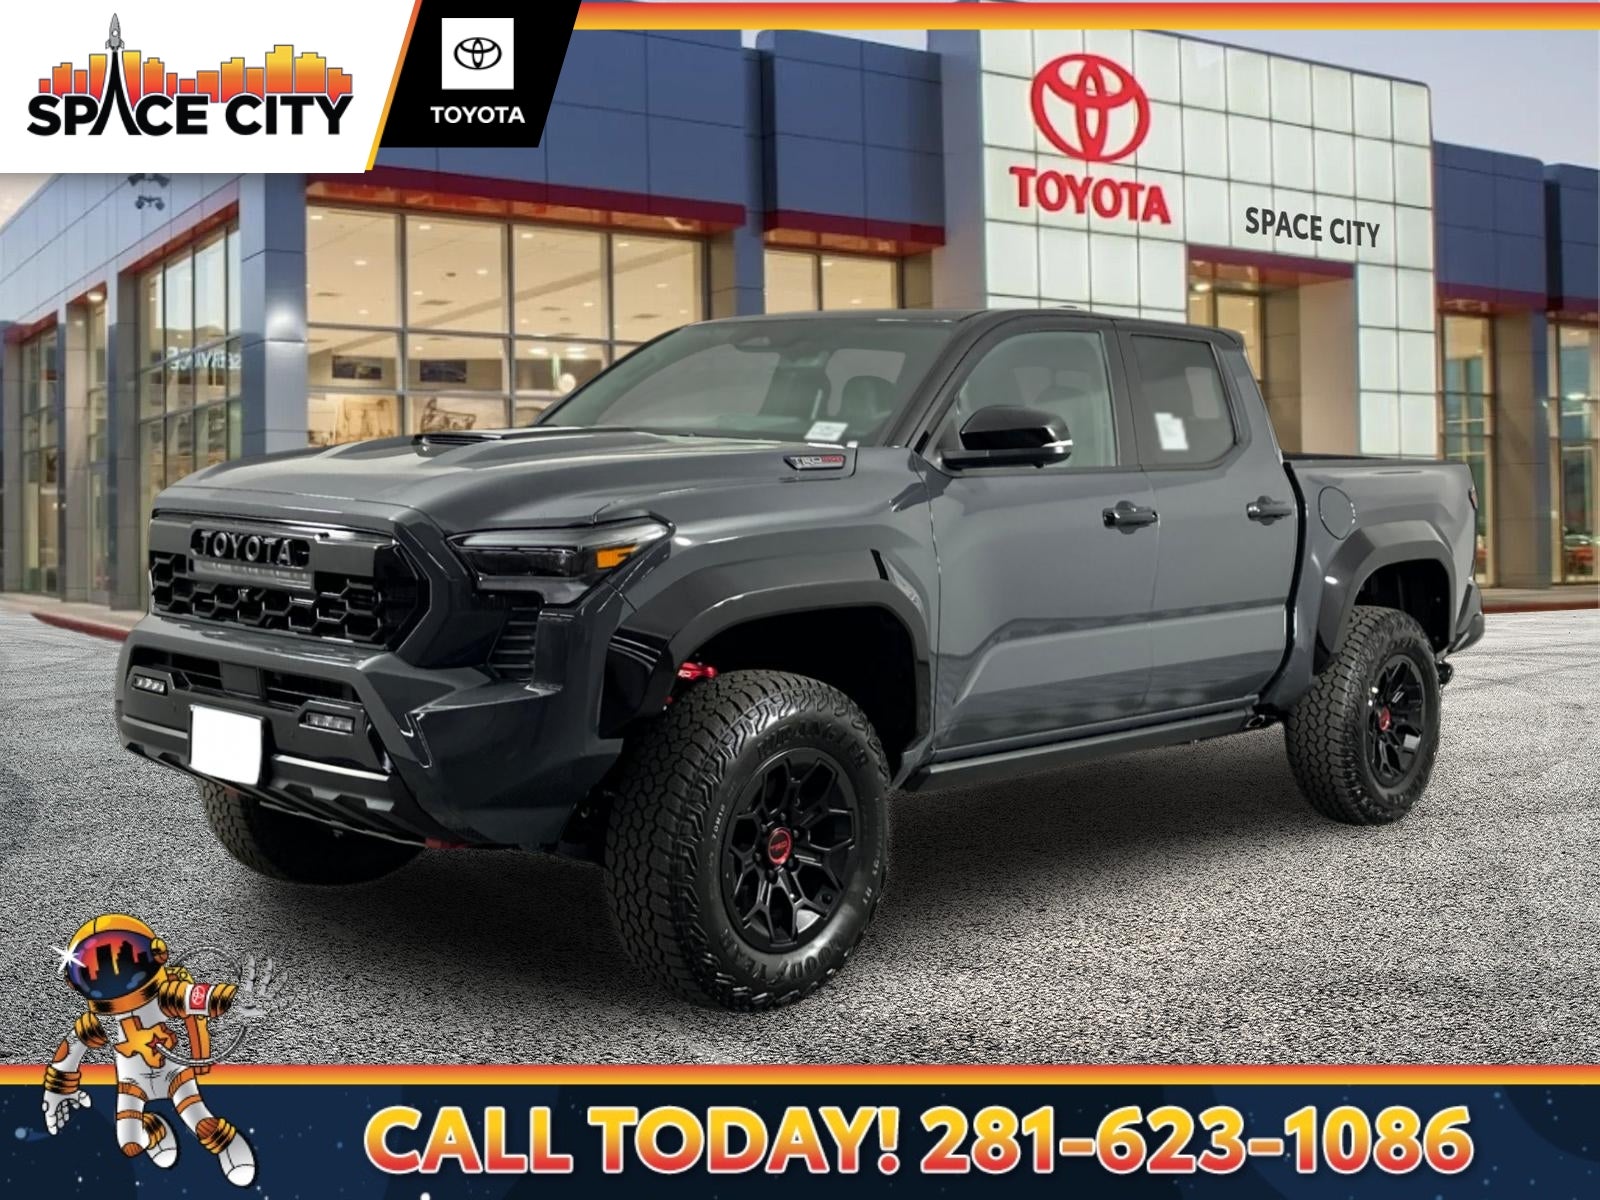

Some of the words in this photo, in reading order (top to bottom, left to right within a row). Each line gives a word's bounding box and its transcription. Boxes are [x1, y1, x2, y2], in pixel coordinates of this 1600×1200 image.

[1009, 166, 1171, 224] TOYOTA
[1245, 206, 1323, 241] SPACE
[1329, 218, 1380, 248] CITY
[198, 531, 293, 565] TOYOTA
